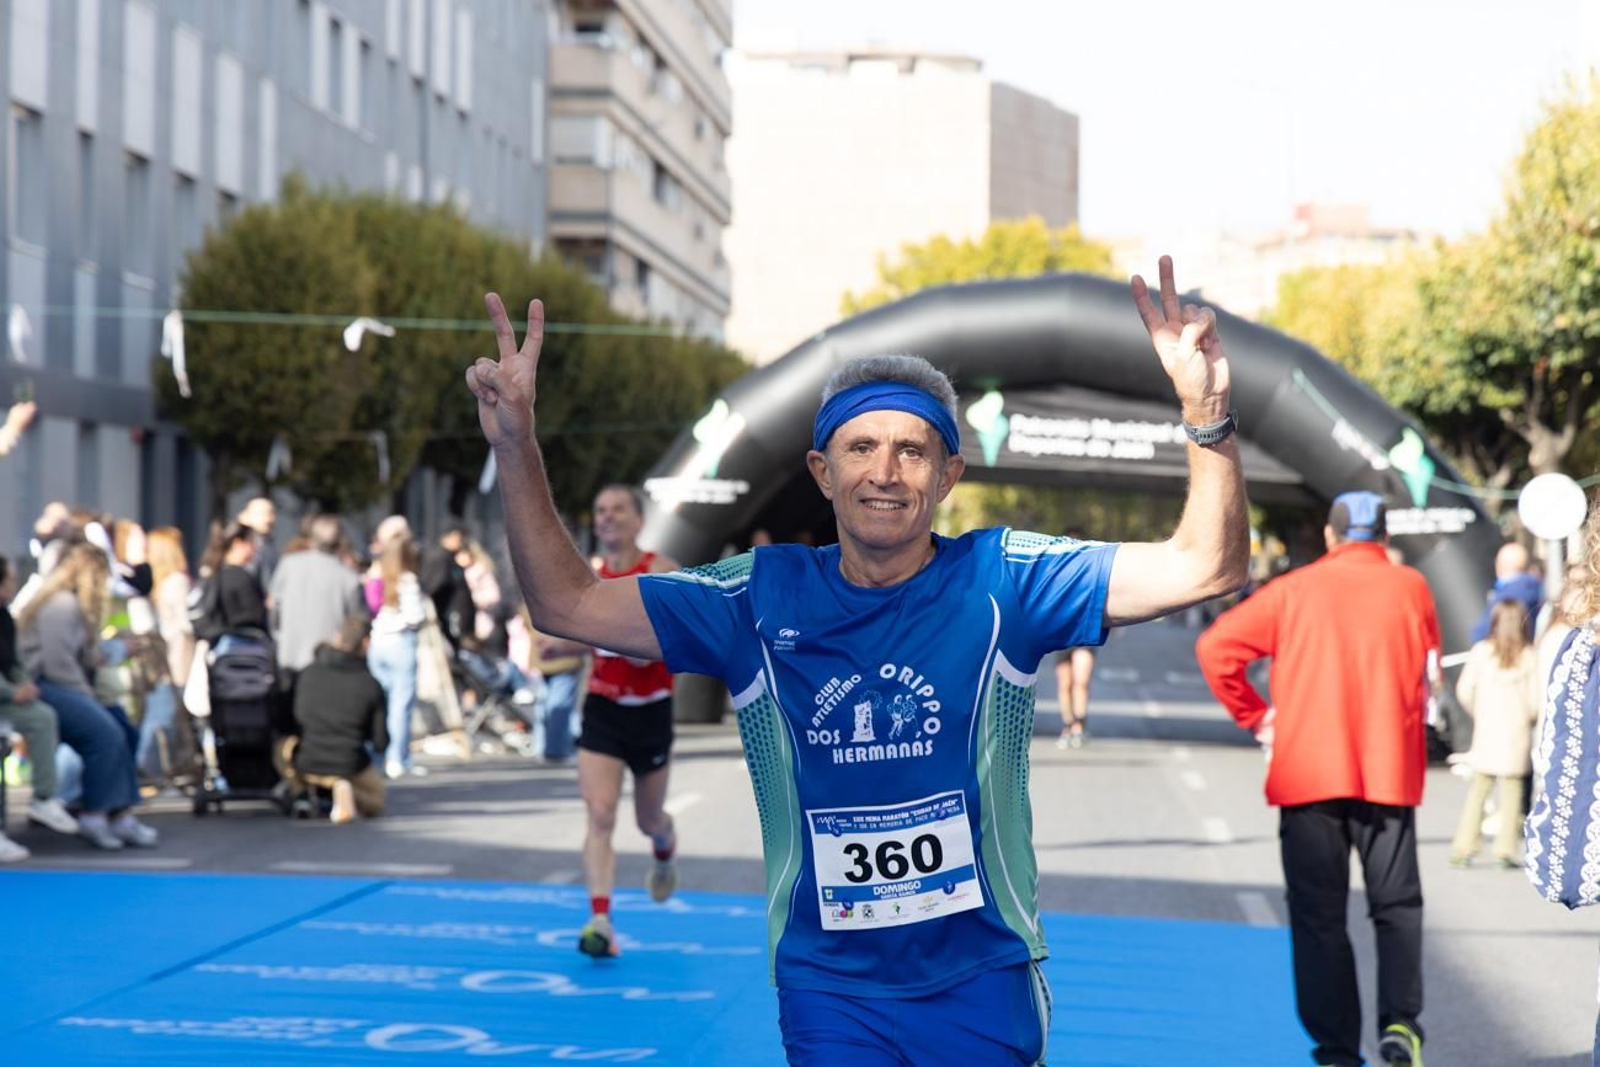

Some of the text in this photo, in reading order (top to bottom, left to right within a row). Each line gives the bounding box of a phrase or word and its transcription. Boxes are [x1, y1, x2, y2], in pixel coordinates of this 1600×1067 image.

[811, 674, 862, 727] ATLETISMO
[815, 677, 841, 705] CLUB
[879, 663, 941, 735] ORIPPO
[806, 729, 841, 745] DOS
[843, 834, 943, 883] 360
[873, 880, 921, 896] DOMINGO
